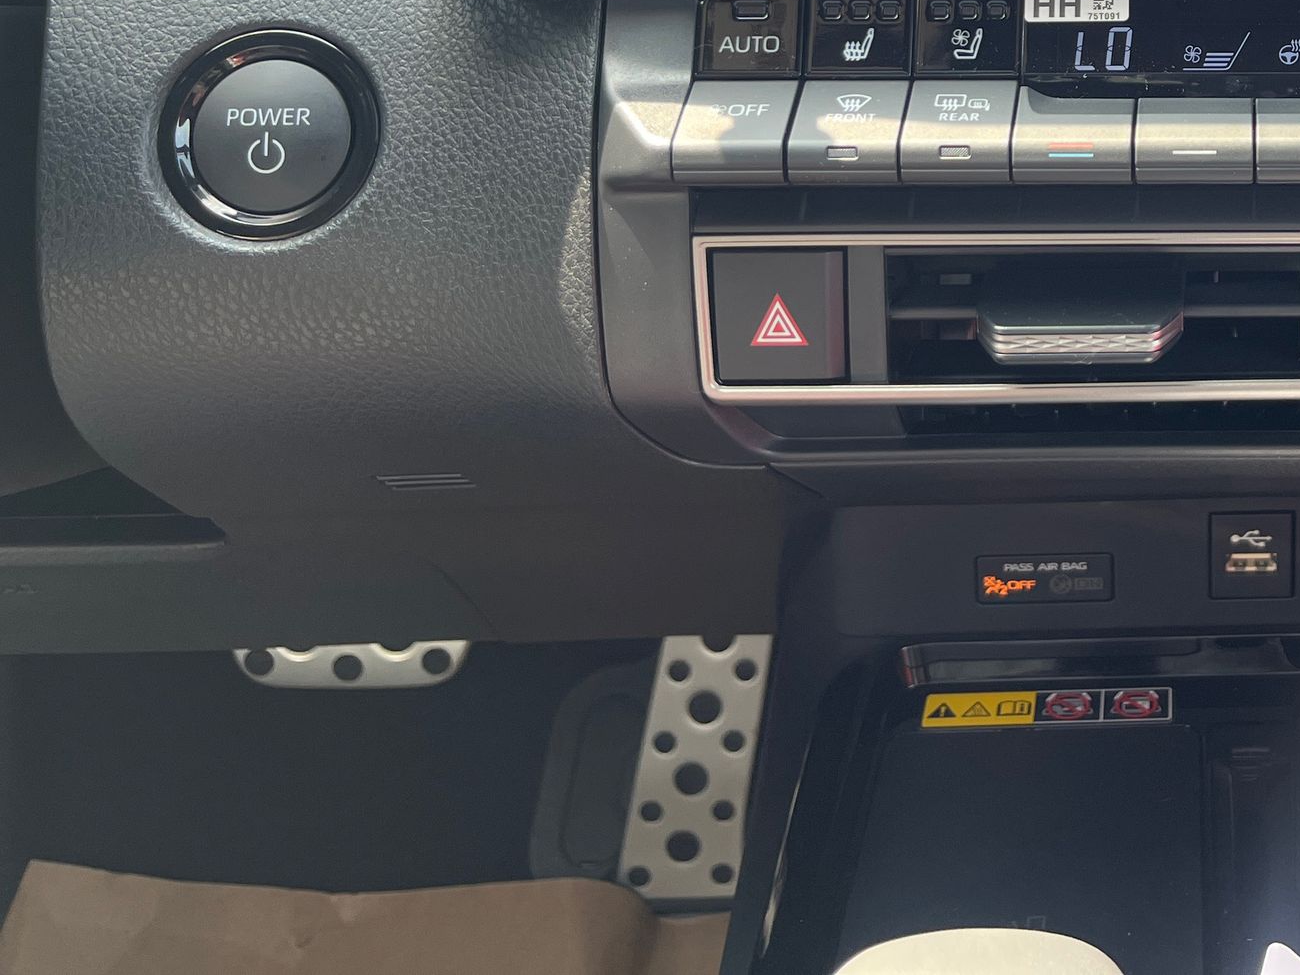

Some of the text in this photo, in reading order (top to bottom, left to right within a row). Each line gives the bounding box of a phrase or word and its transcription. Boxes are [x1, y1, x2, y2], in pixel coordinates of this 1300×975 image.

[719, 35, 780, 54] AUTO
[728, 104, 770, 117] OFF
[227, 108, 311, 126] POWER
[825, 113, 876, 122] FRONT
[939, 112, 979, 121] REAR
[1003, 563, 1034, 572] PASS
[1060, 562, 1087, 570] BAG
[1007, 580, 1037, 590] OFF
